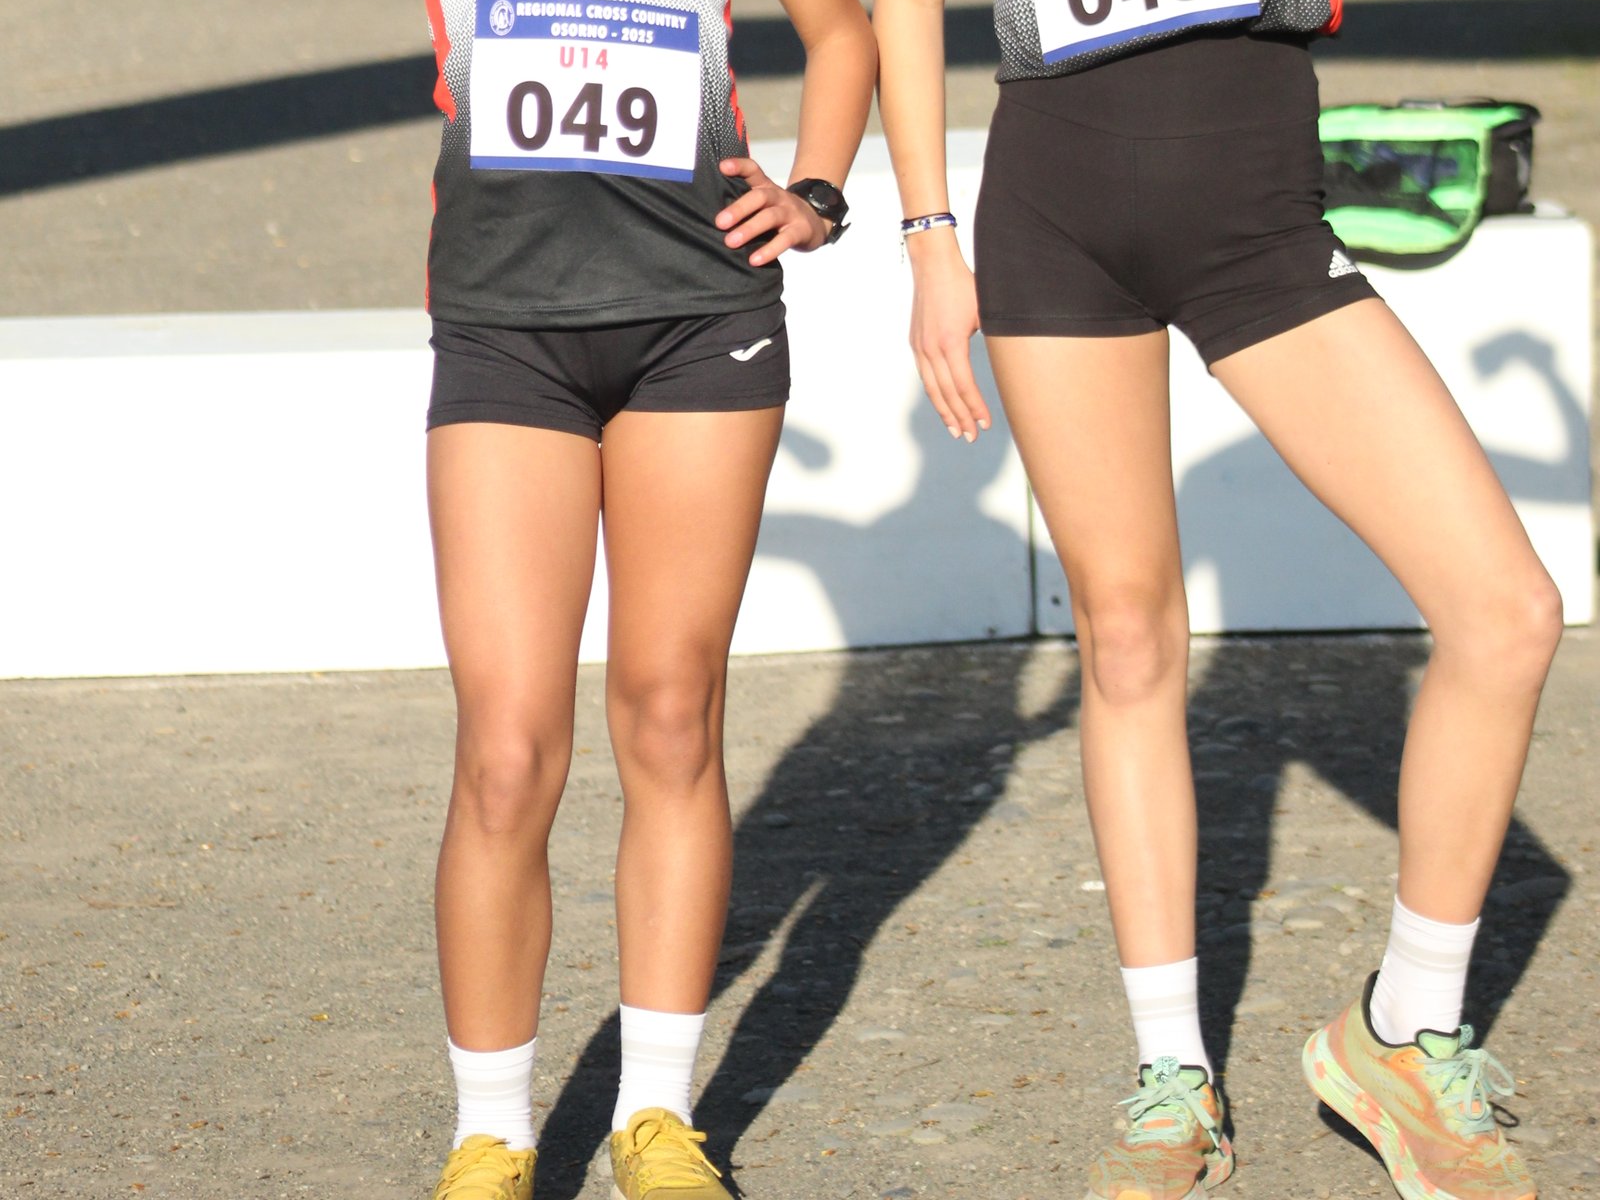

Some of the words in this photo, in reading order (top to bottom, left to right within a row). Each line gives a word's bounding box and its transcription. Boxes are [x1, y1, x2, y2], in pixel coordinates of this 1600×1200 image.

[516, 2, 582, 17] REGIONAL
[586, 4, 627, 21] CROSS
[631, 9, 687, 29] COUNTRY
[551, 22, 608, 39] OSORNO
[621, 27, 655, 44] 2025
[560, 46, 608, 70] U14
[506, 80, 658, 158] 049
